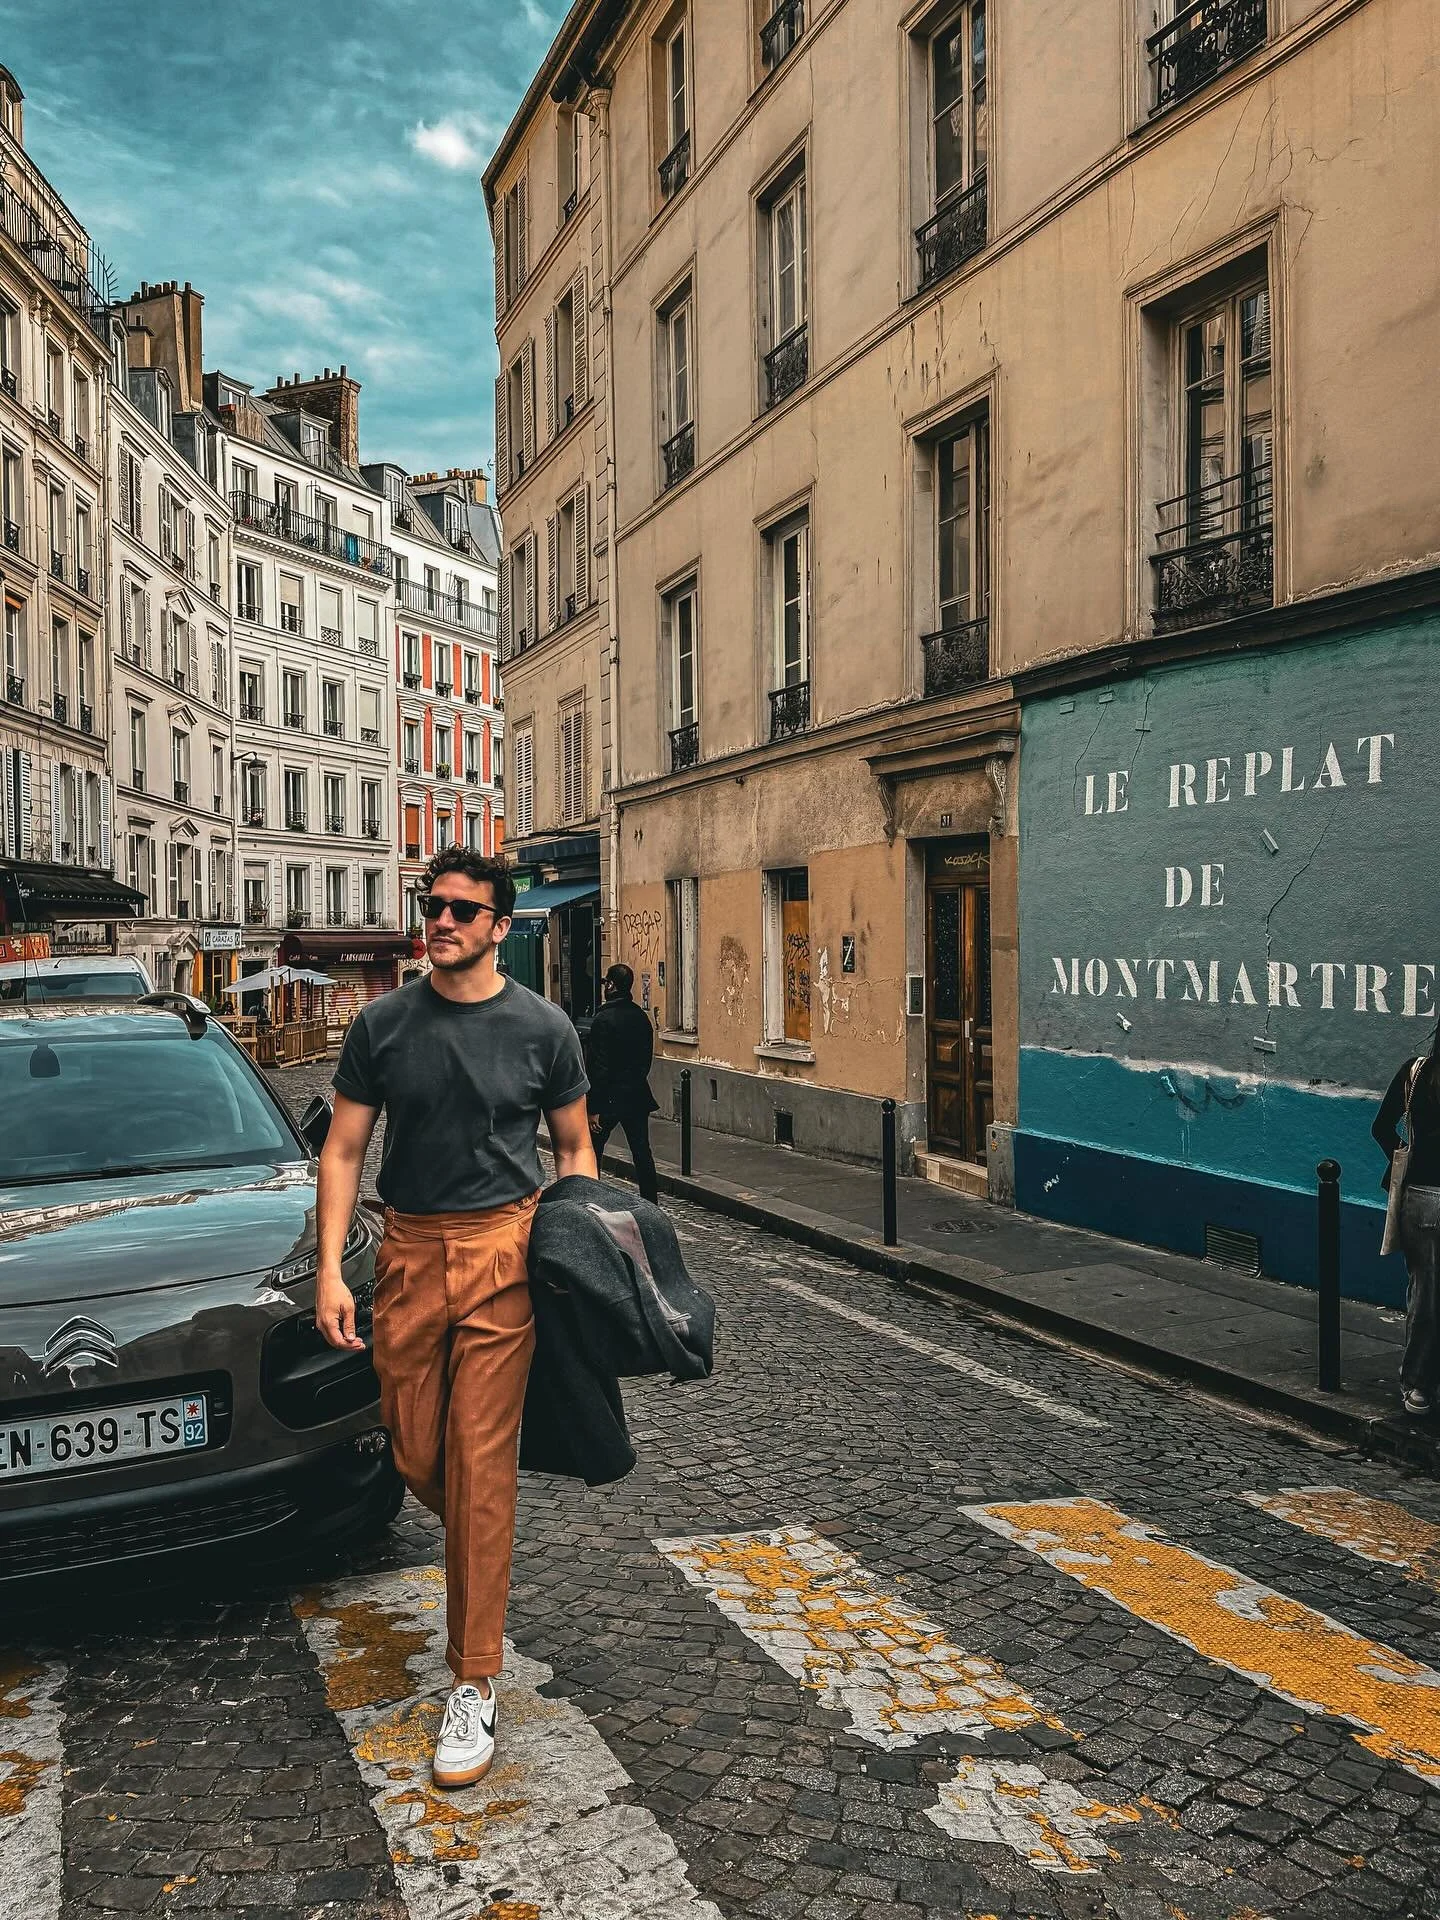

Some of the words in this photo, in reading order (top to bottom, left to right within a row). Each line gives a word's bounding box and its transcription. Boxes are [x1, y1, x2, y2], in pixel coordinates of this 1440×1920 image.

[1084, 770, 1130, 815] LE
[1167, 733, 1396, 809] REPLAT
[942, 815, 950, 827] 31
[1164, 863, 1225, 908] DE
[1050, 957, 1437, 1018] MONTMARTRE
[185, 1423, 204, 1441] 92
